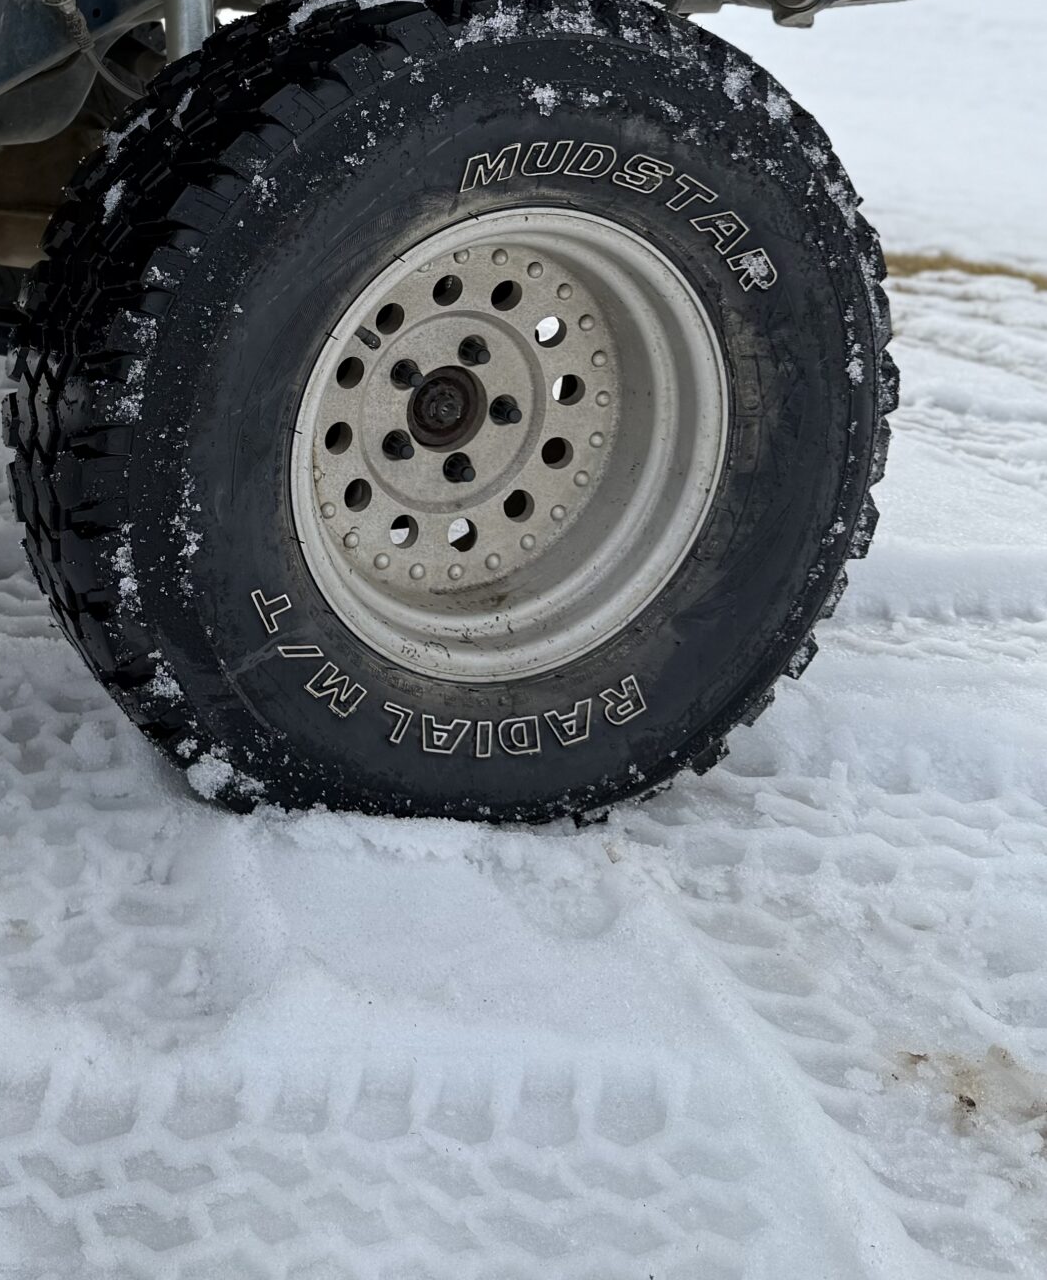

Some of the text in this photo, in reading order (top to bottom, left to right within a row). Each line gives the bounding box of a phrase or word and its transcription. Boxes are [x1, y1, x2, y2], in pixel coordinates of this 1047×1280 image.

[459, 140, 779, 292] MUDSTAR
[251, 588, 648, 758] RADIAL M/T
